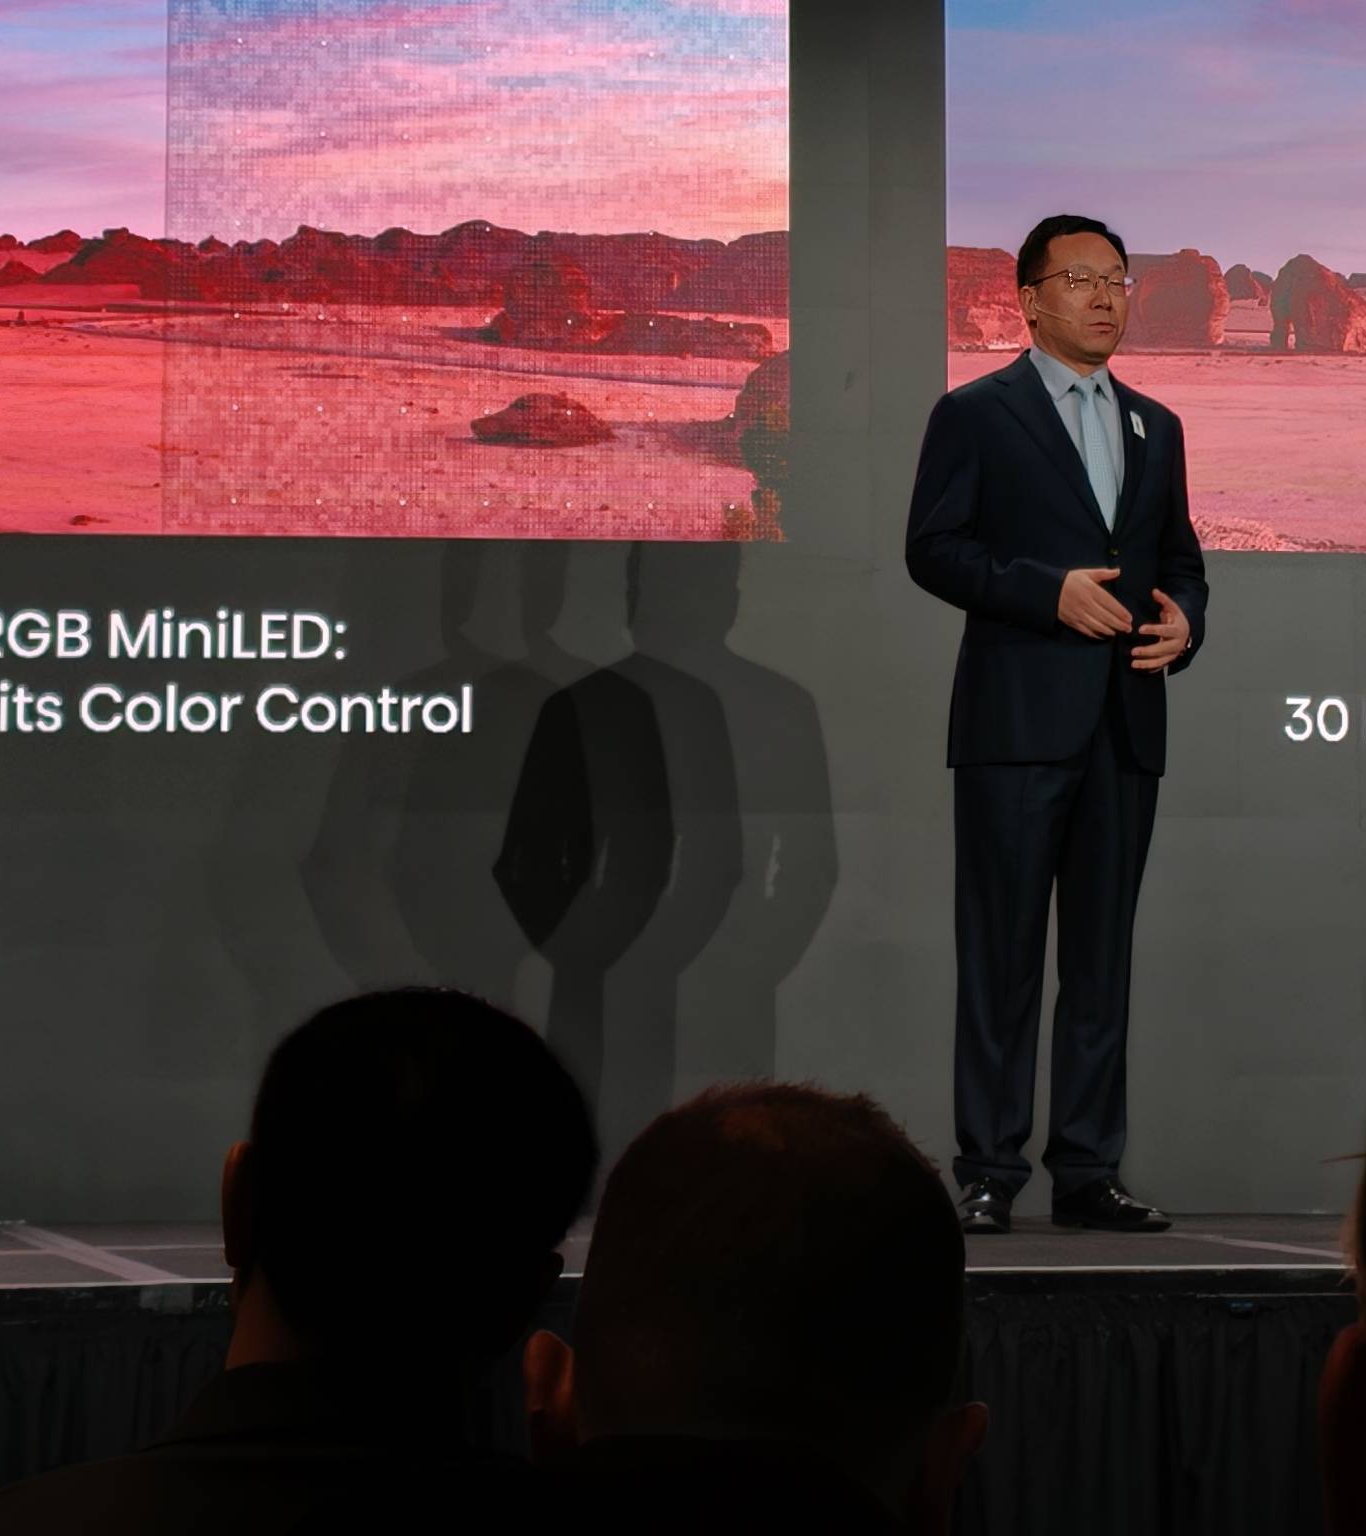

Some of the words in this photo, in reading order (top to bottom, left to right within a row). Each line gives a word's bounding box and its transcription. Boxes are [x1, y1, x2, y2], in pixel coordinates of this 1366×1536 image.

[108, 607, 346, 660] MiniLED:
[79, 682, 244, 733] Color
[256, 682, 473, 733] Control
[1283, 695, 1350, 742] 30
